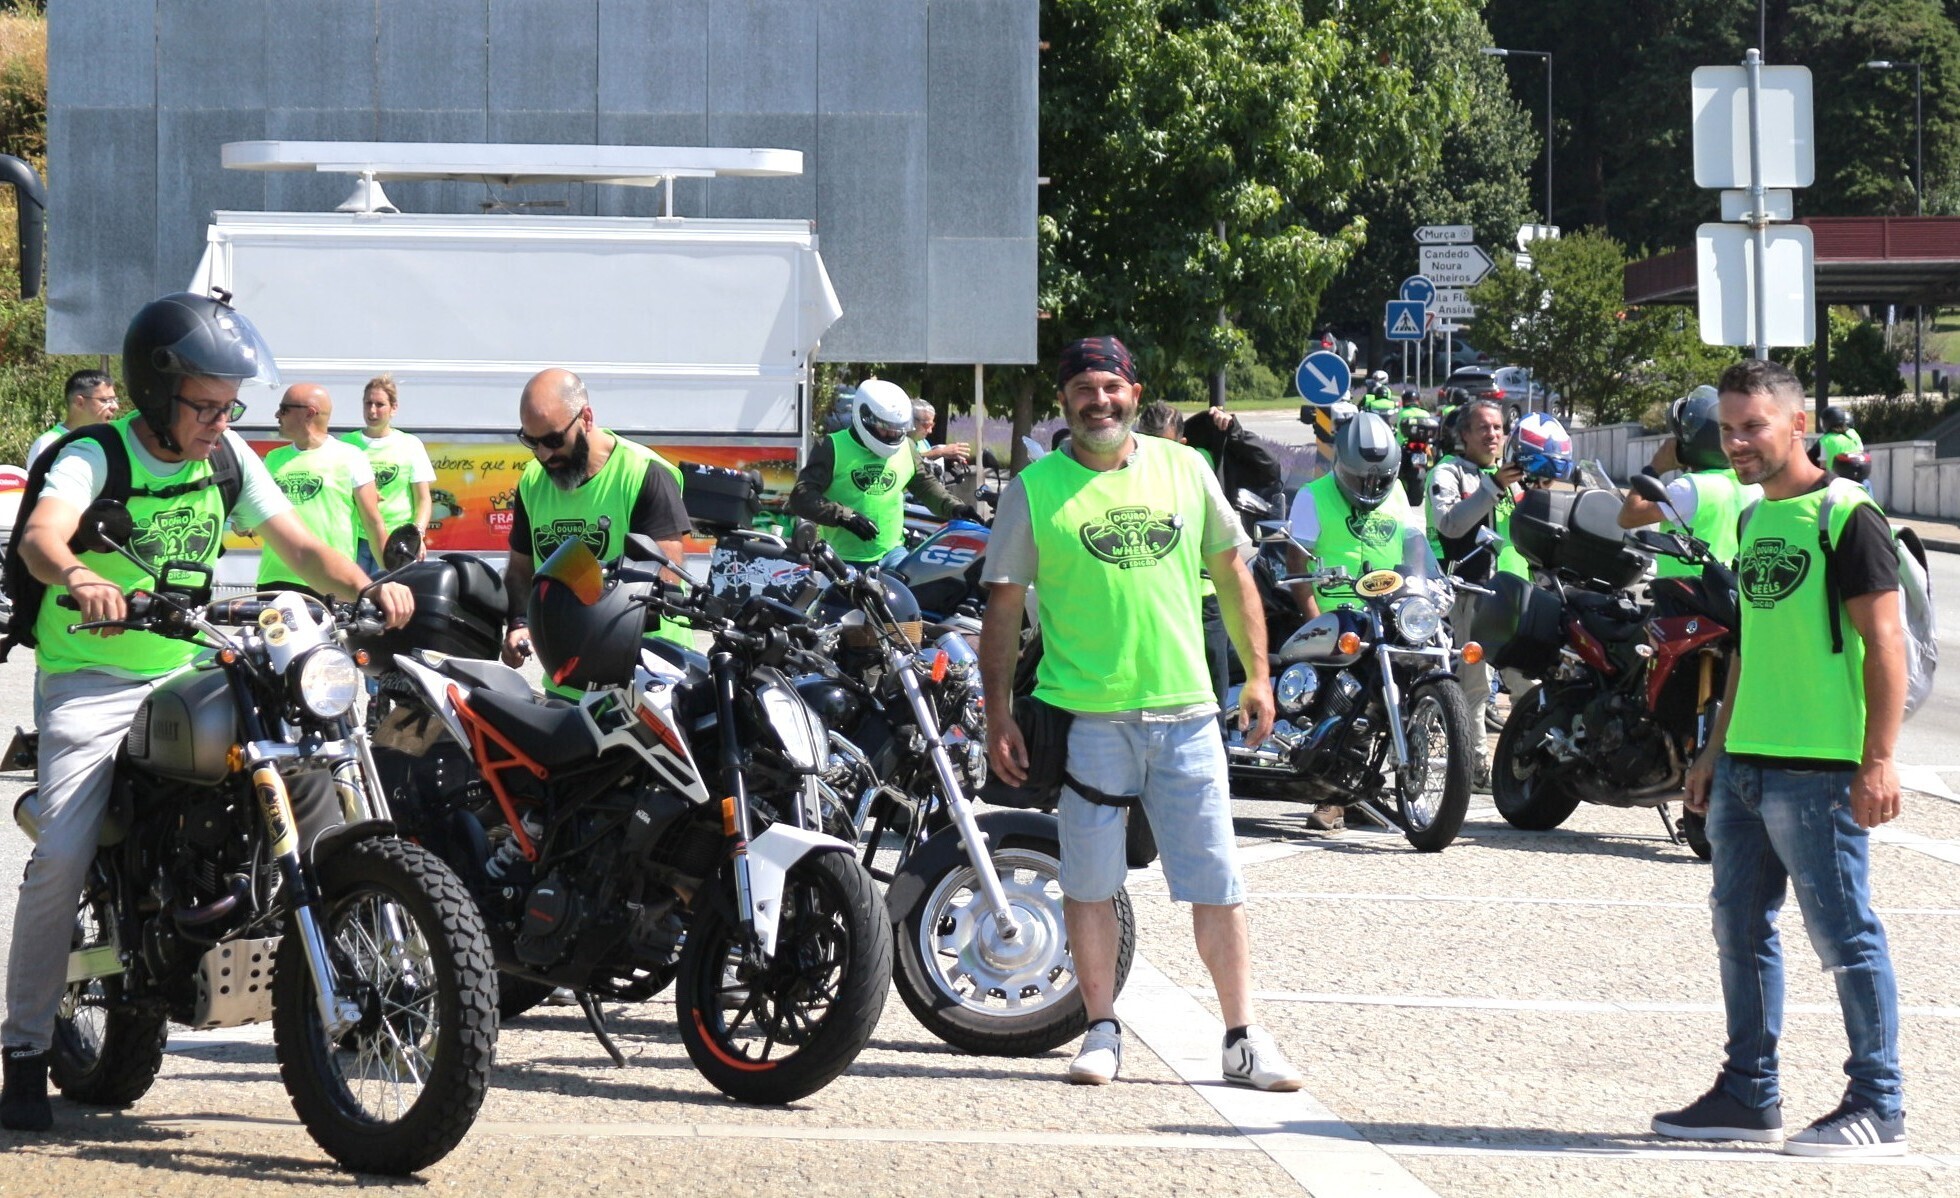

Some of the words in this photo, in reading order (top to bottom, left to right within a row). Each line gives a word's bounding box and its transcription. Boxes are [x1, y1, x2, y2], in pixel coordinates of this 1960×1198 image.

[1425, 230, 1456, 239] Murça
[1424, 249, 1470, 259] Candedo
[1432, 262, 1463, 270] Noura
[1453, 292, 1470, 302] Flo
[481, 460, 505, 479] que
[161, 515, 189, 527] DOURO
[1113, 512, 1146, 523] DOURO
[556, 525, 583, 533] DOURO
[1129, 531, 1140, 546] 2
[167, 538, 178, 554] 2
[1112, 541, 1160, 556] WHEELS
[1756, 546, 1779, 555] DOURO
[920, 545, 978, 567] GS
[1757, 567, 1766, 583] 2
[635, 809, 651, 825] KTM
